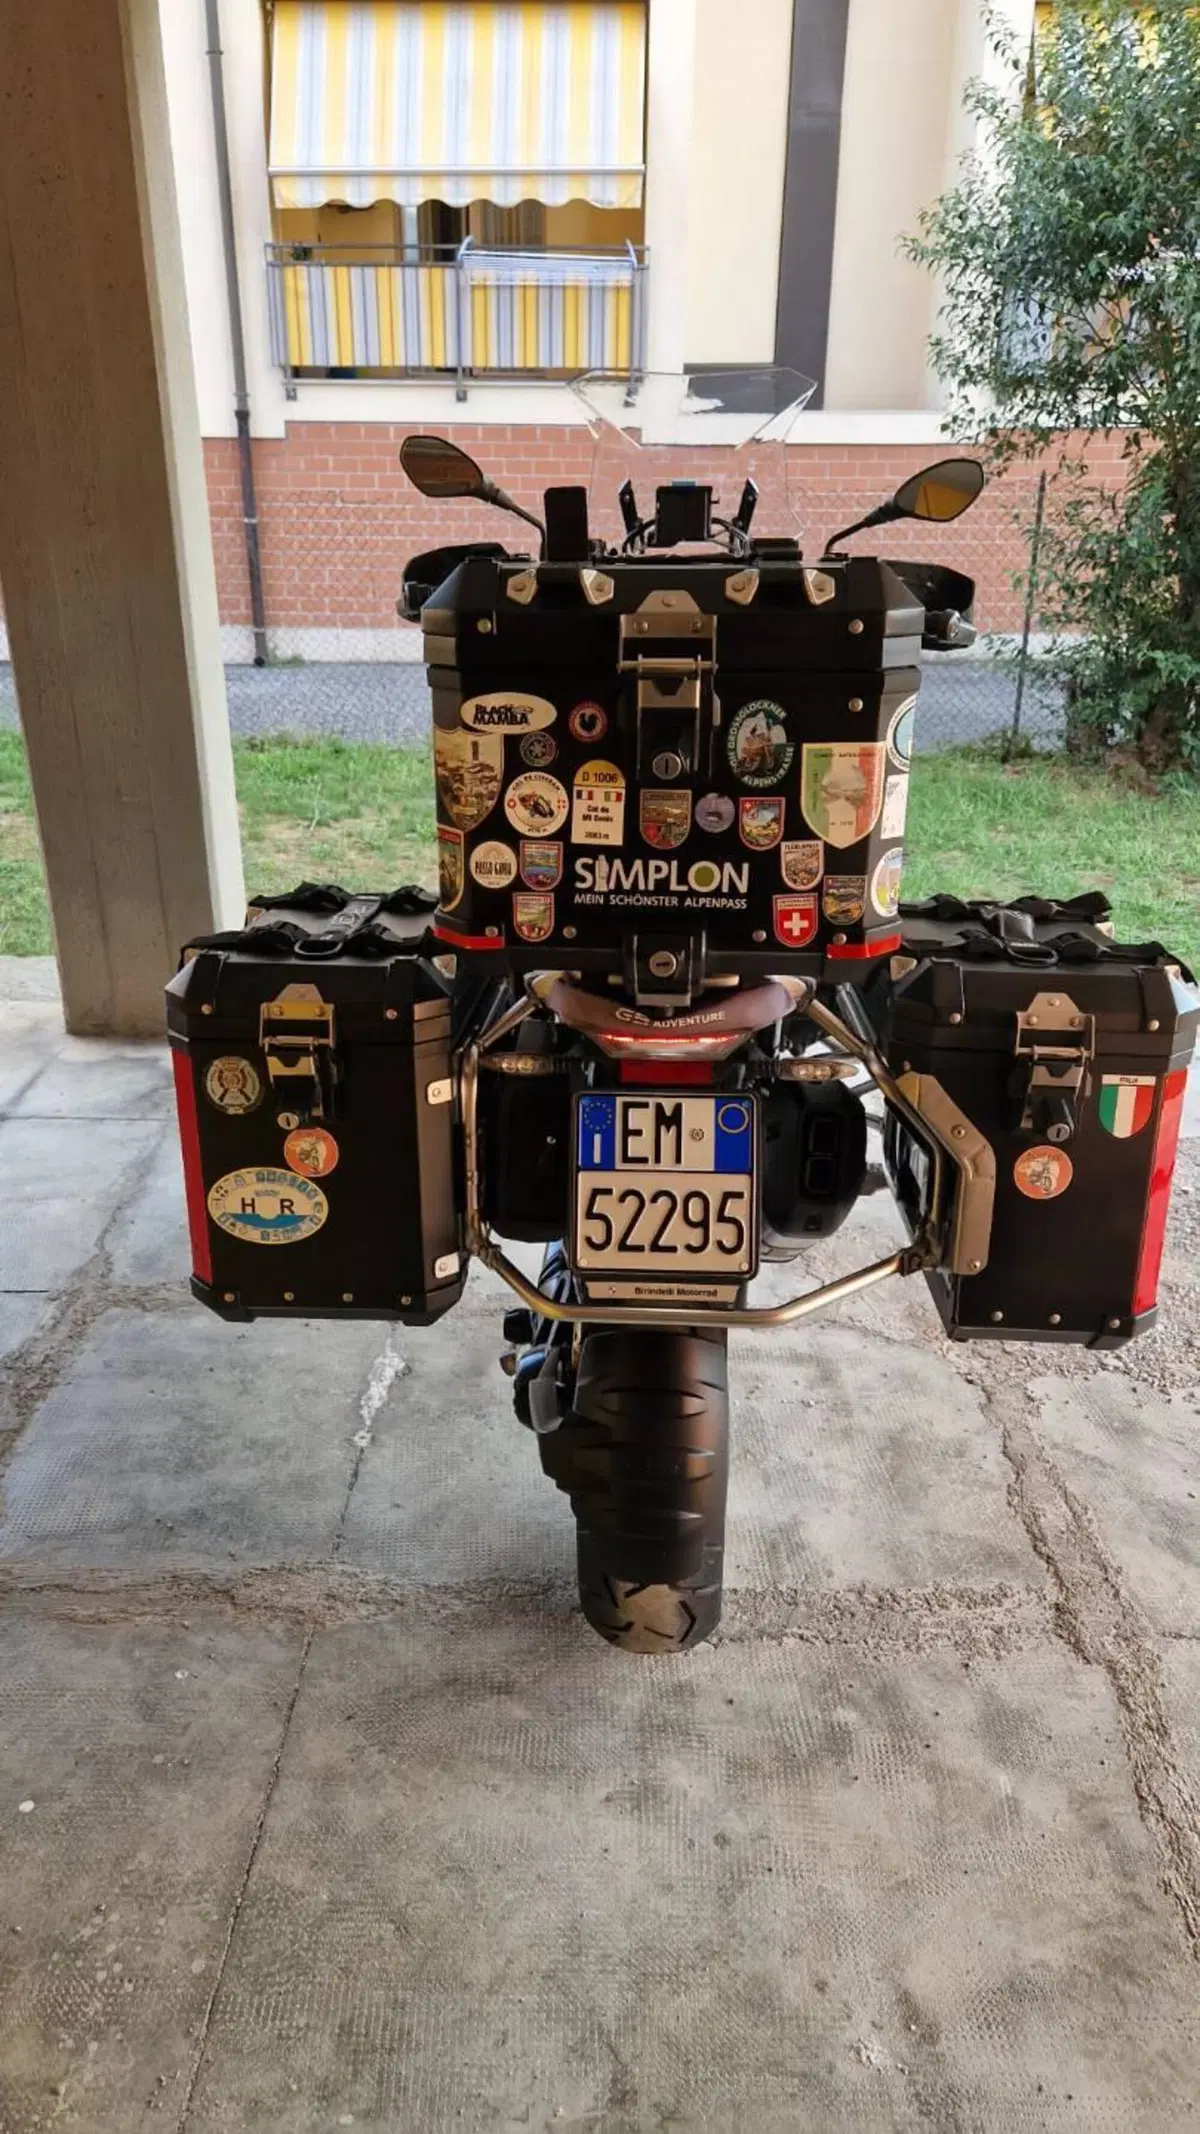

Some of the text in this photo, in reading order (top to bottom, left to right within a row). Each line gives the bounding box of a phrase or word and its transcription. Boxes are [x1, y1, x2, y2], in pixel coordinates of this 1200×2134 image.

[475, 704, 513, 714] BLACK
[473, 712, 531, 726] MAMBA
[574, 855, 749, 893] SIMPLON
[574, 894, 748, 909] MEIN SCHÖNSTER ALPENPASS
[616, 1007, 726, 1028] GS ADVENTURE
[621, 1101, 683, 1164] EM
[585, 1188, 745, 1255] 52295
[677, 1287, 718, 1297] Motorrad
